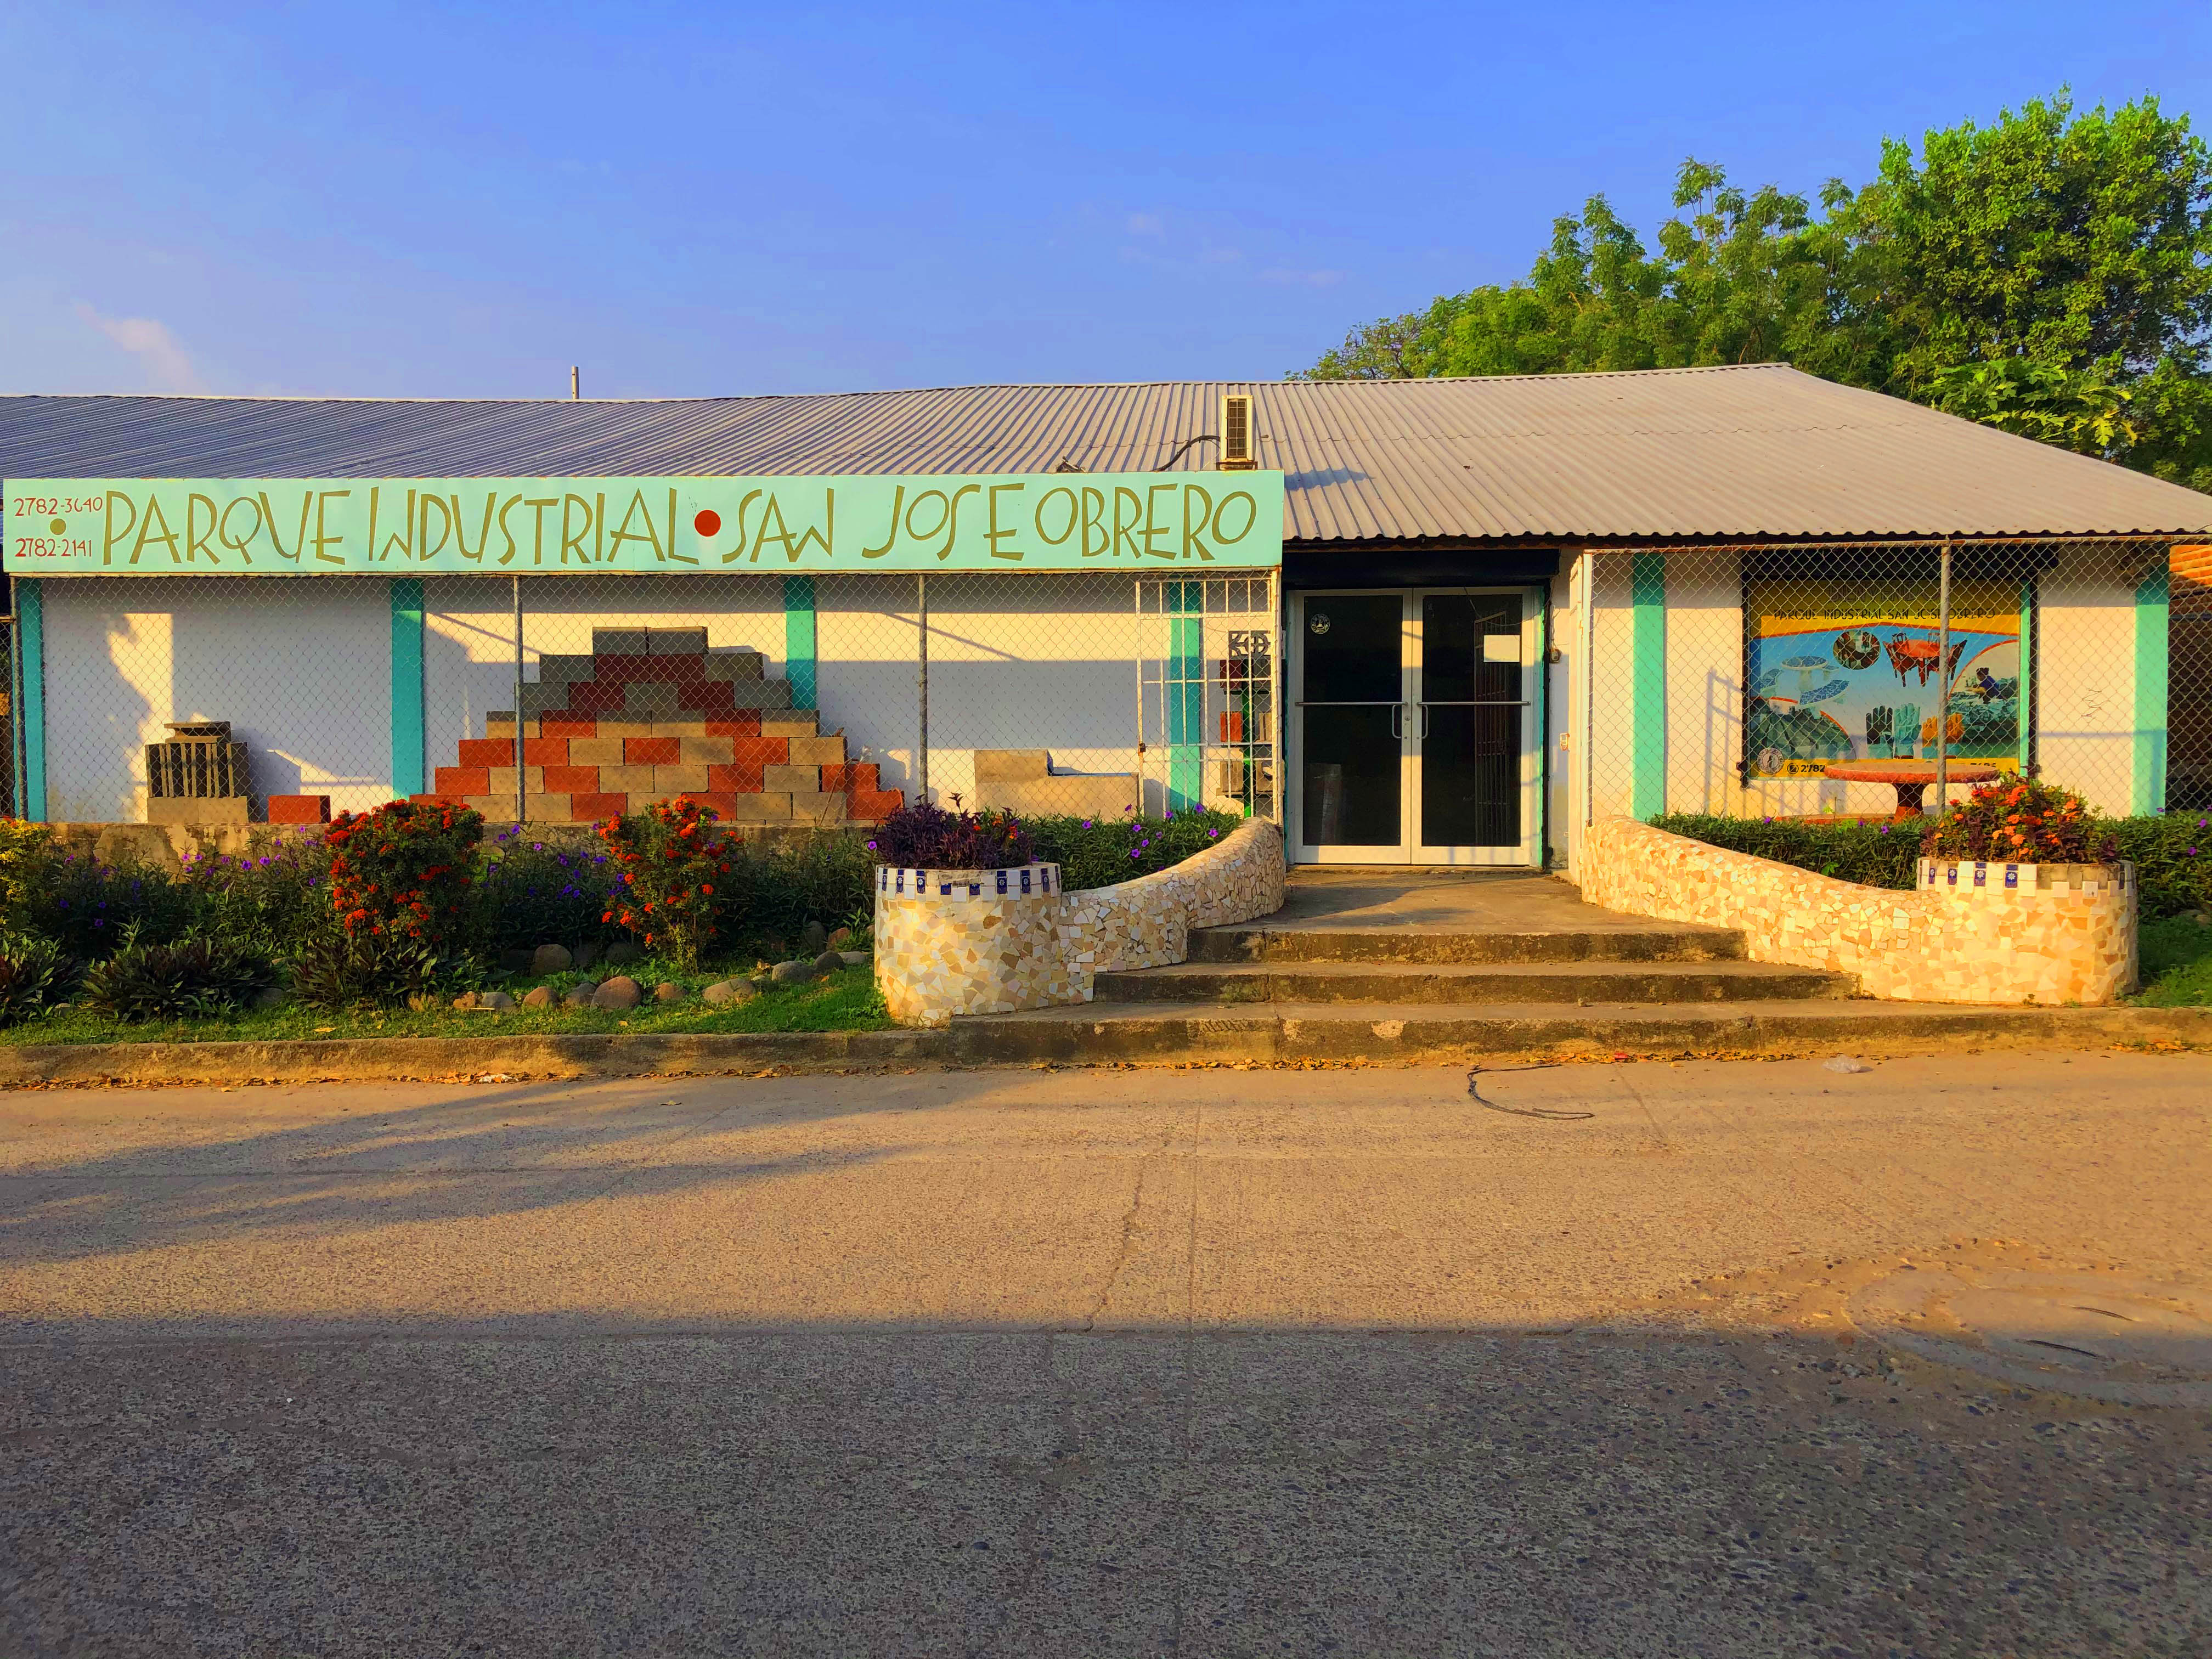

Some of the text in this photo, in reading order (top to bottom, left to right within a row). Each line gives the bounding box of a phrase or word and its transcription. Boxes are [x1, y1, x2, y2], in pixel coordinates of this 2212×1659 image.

[13, 496, 103, 516] 2782-3640
[103, 483, 1257, 565] PARQUE INDUSTRIAL SAN JOSE OBRERO
[14, 538, 92, 557] 2782-2141
[1774, 608, 1818, 620] PARQUE
[1824, 608, 1884, 620] INDUSTRIAL
[1887, 608, 1909, 620] SAN
